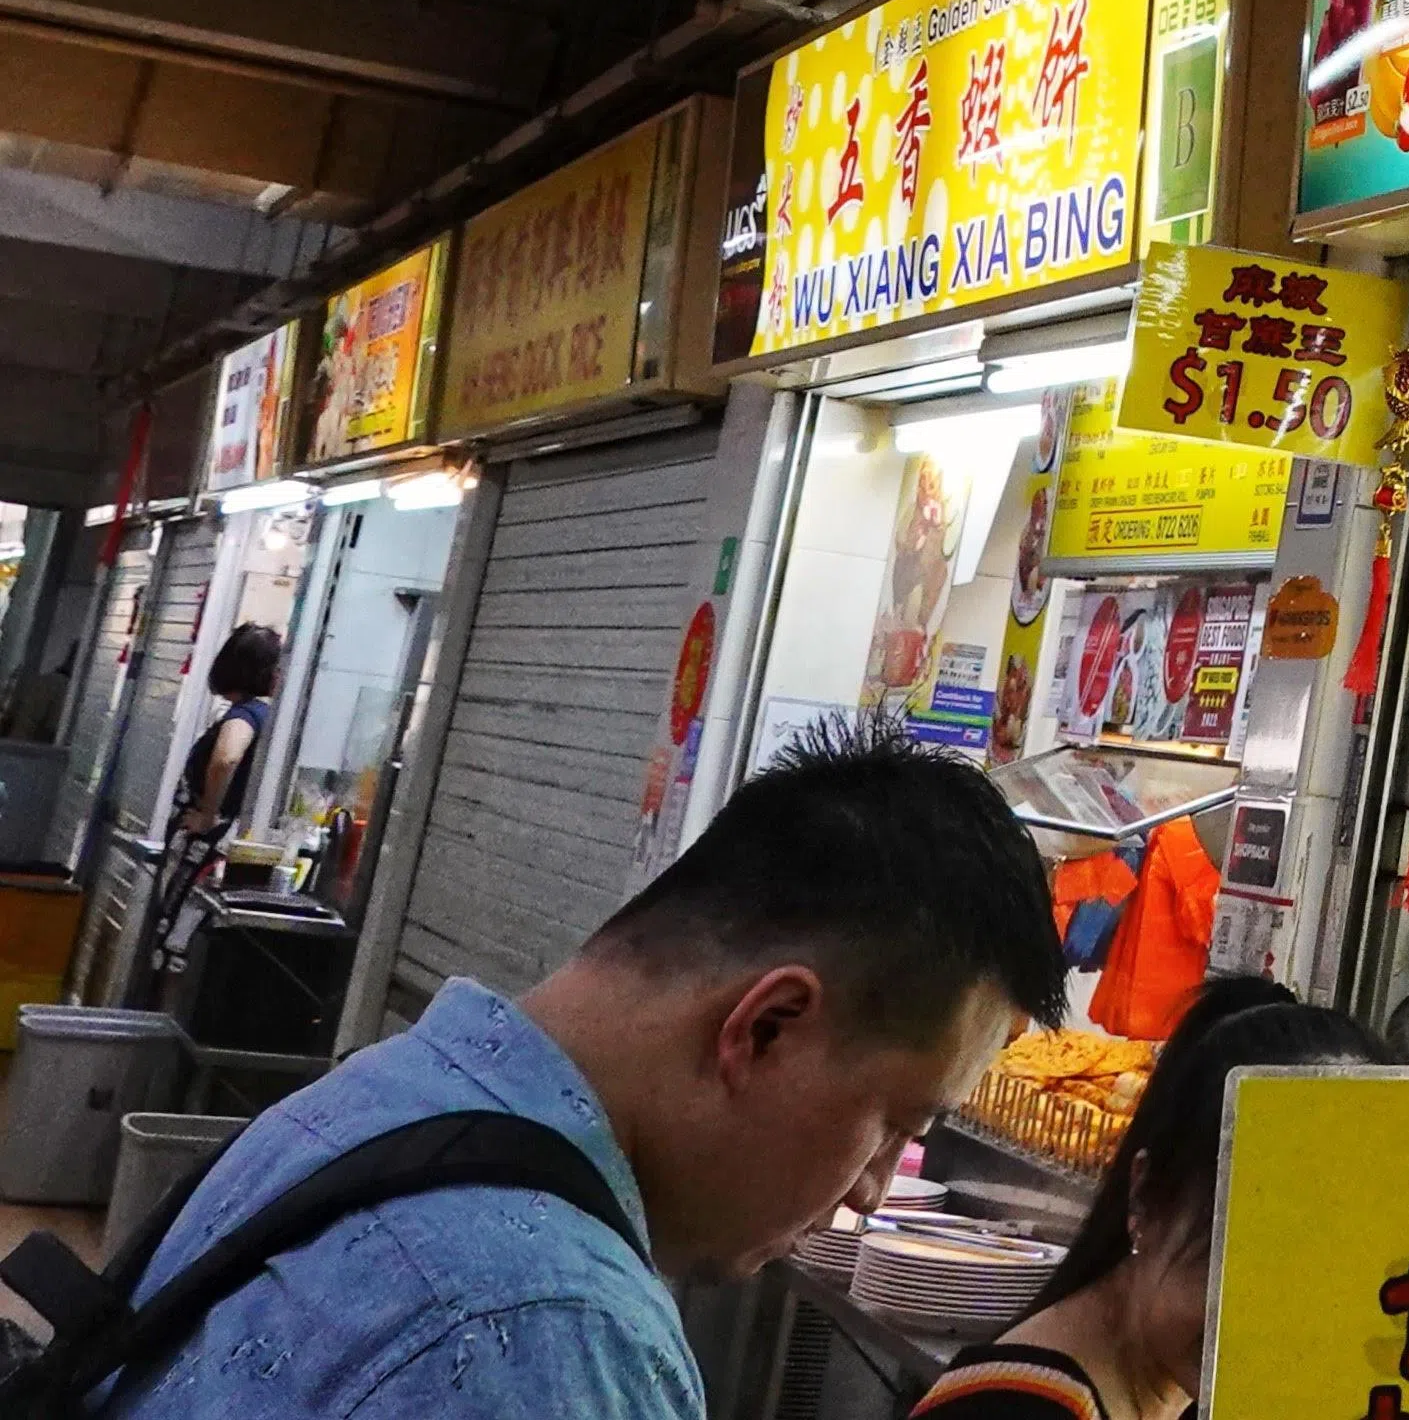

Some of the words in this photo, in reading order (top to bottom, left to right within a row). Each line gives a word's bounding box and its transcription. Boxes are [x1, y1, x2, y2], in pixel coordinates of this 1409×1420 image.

[1174, 87, 1197, 170] B
[793, 264, 838, 329] WU
[843, 234, 940, 317] XIANG
[949, 213, 1009, 290] XIA
[1024, 177, 1125, 268] BING
[1194, 307, 1348, 368] 甘蔗王
[1163, 348, 1353, 440] $1.50
